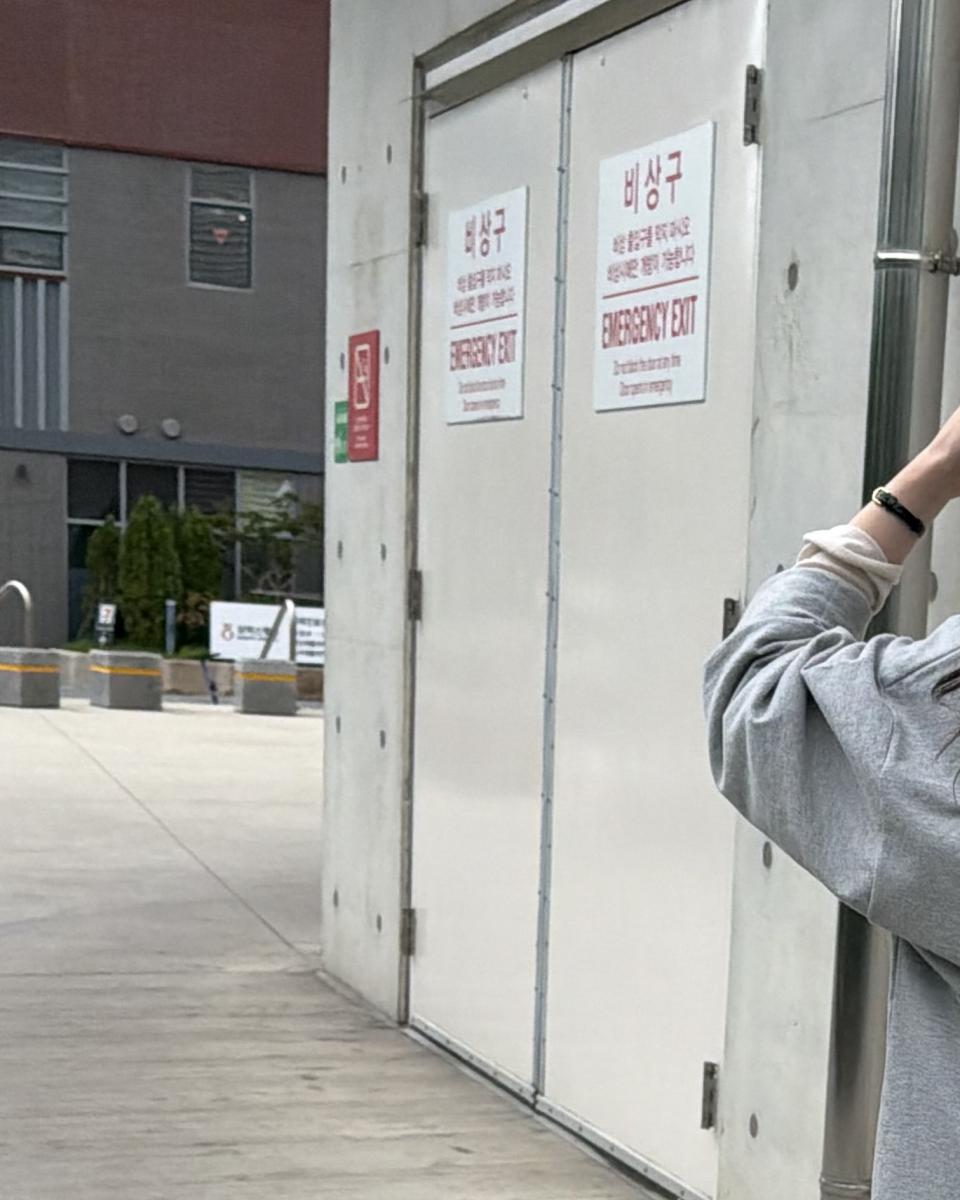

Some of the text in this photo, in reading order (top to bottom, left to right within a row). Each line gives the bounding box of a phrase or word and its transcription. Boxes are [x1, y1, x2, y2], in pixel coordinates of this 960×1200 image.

[623, 150, 683, 214] 비상구
[464, 207, 506, 260] 비상구
[498, 329, 517, 365] EXIT
[602, 295, 698, 350] EMERGENCY EXIT
